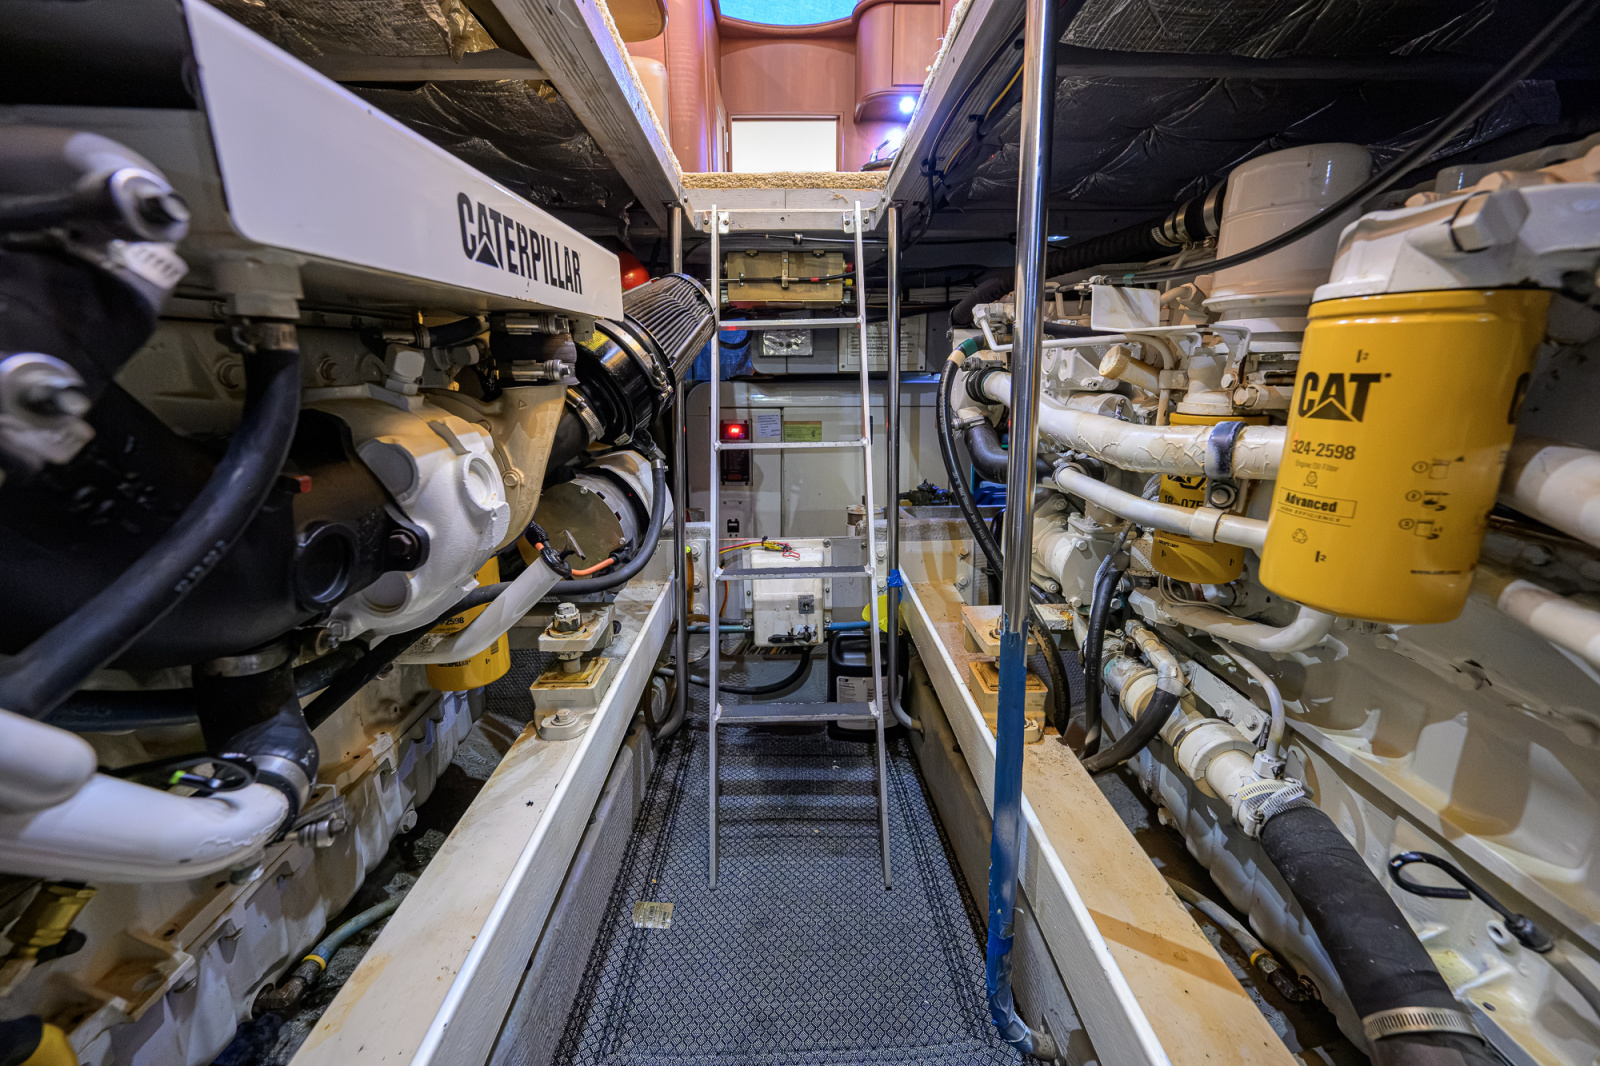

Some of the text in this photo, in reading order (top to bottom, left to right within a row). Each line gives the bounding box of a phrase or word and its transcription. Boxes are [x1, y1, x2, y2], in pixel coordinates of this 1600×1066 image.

[457, 192, 583, 295] CATERPILLAR
[1298, 372, 1382, 423] CAT
[1292, 438, 1356, 461] 324-2598
[1285, 492, 1338, 512] Advanced
